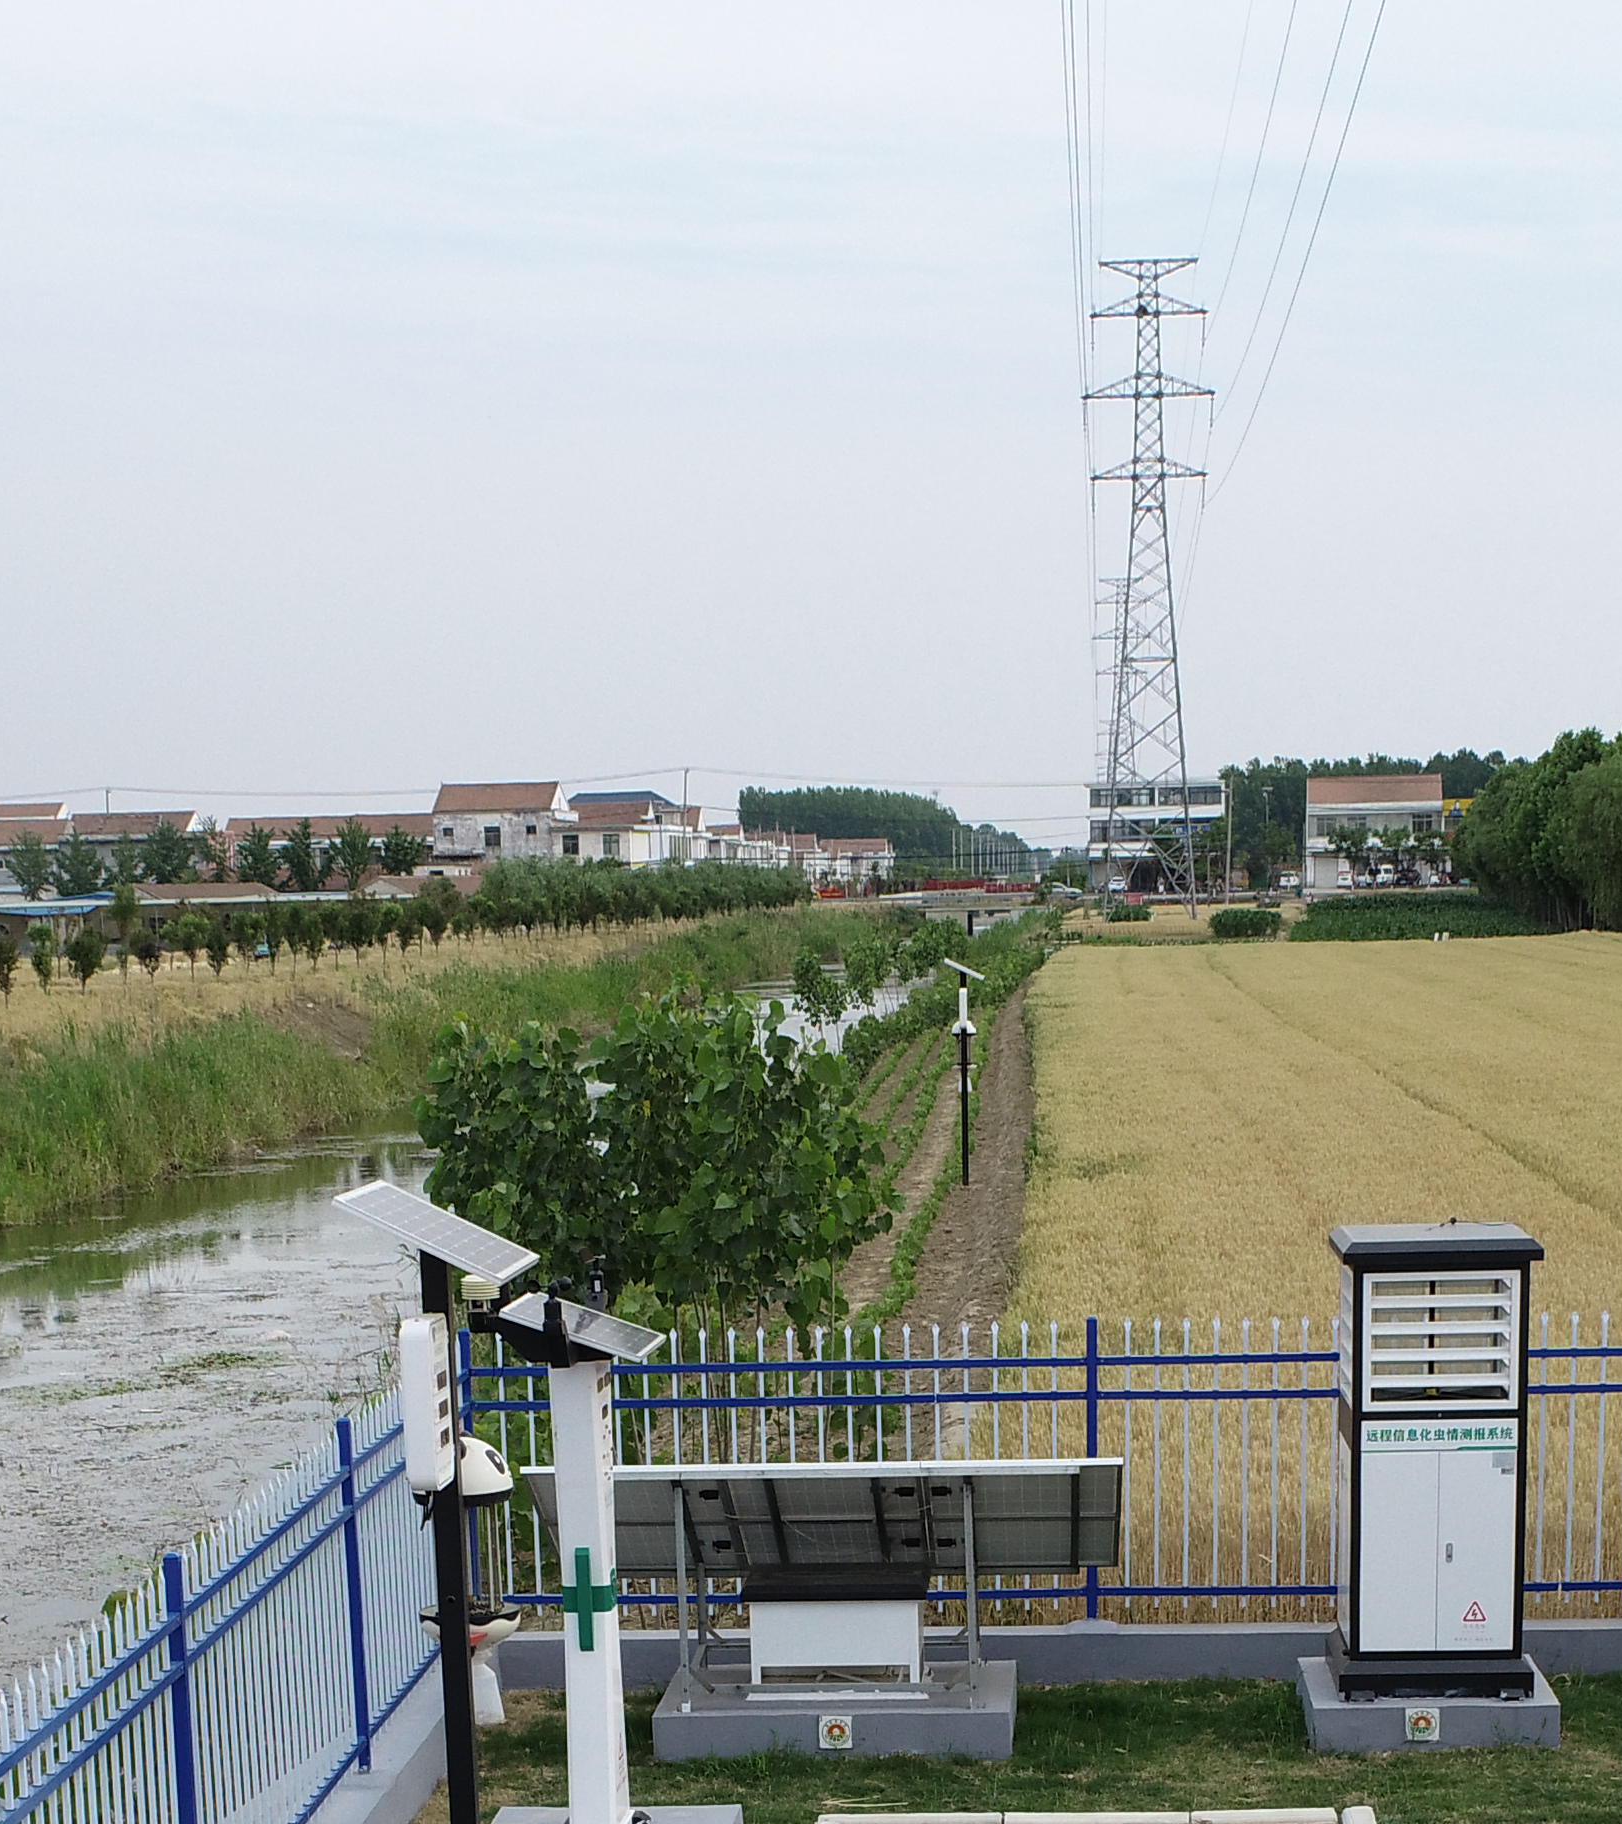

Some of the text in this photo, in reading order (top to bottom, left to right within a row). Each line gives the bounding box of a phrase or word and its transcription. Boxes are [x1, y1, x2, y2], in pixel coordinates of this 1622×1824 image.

[1366, 1426, 1514, 1443] 远程信息化虫情测报系统
